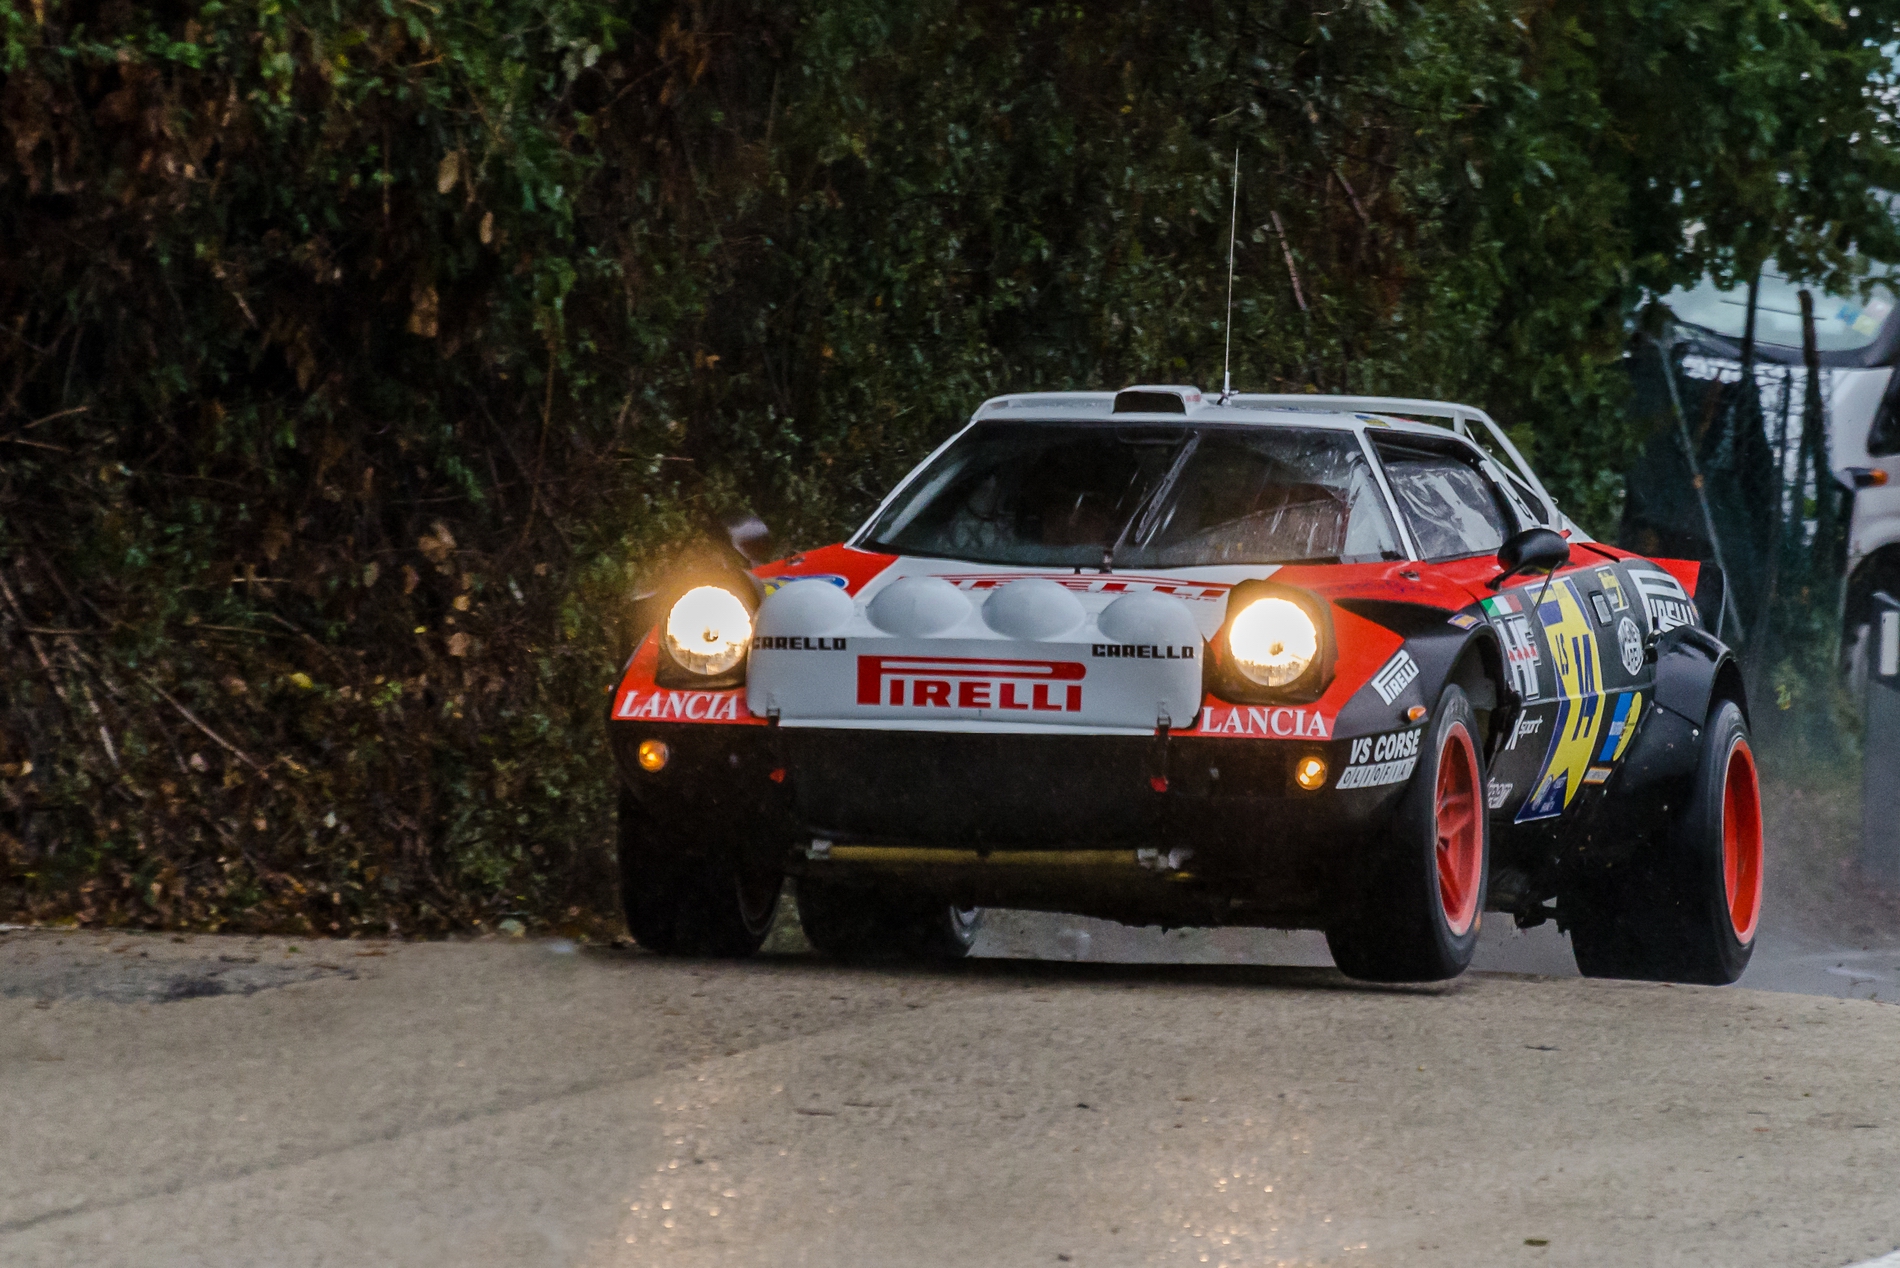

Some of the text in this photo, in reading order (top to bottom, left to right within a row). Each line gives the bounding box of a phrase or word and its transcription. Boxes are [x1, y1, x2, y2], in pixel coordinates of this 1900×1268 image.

[752, 637, 847, 650] CARELLO
[1092, 644, 1194, 659] CARELLO
[857, 655, 1087, 712] PIRELLI
[1371, 649, 1420, 706] PIRELLI
[618, 691, 738, 720] LANCIA
[1202, 707, 1329, 738] LANCIA
[1349, 728, 1422, 765] VS CORSE
